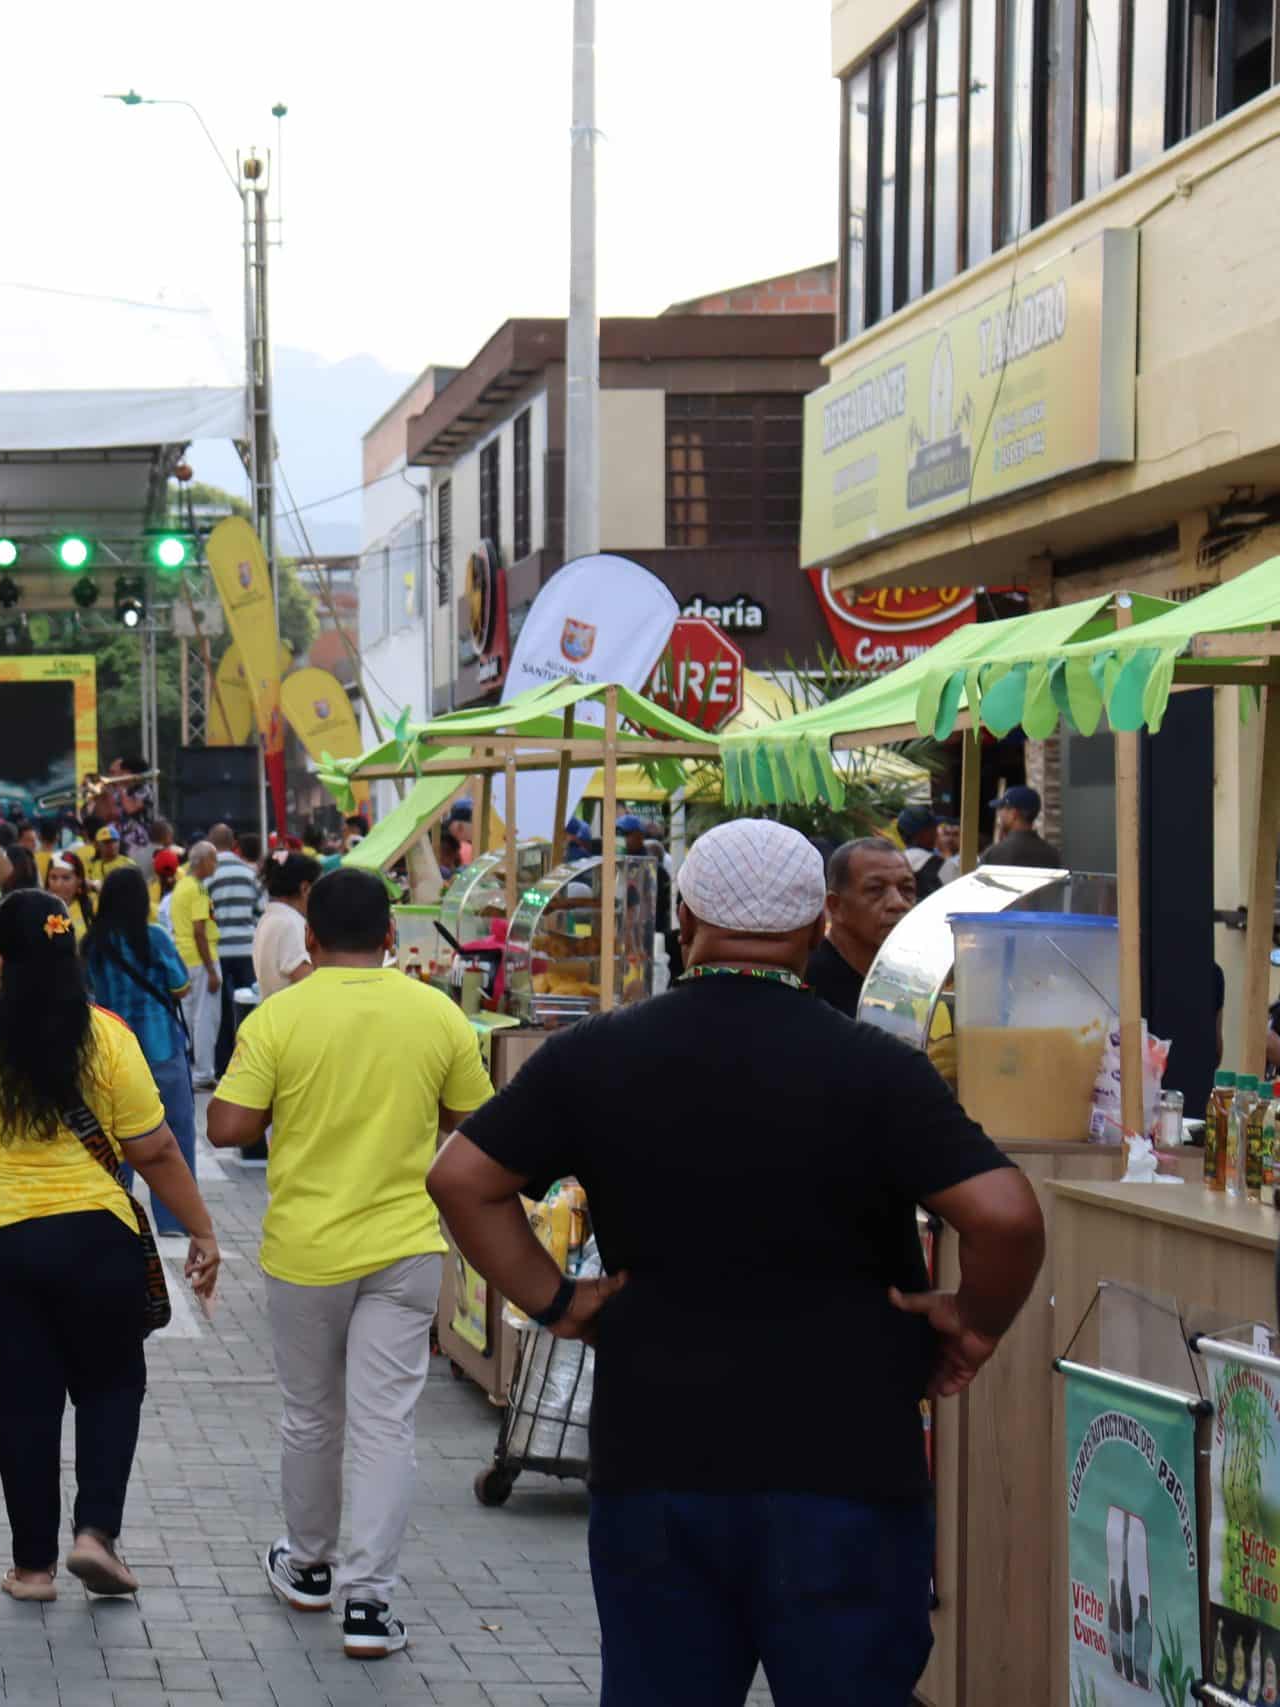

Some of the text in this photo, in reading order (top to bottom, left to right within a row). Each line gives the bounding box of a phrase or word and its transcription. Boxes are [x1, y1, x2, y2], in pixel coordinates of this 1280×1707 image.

[681, 598, 763, 627] dería
[855, 636, 901, 664] Con
[648, 661, 733, 703] ARE
[1072, 1581, 1104, 1623] Viche
[1073, 1613, 1108, 1657] Curao
